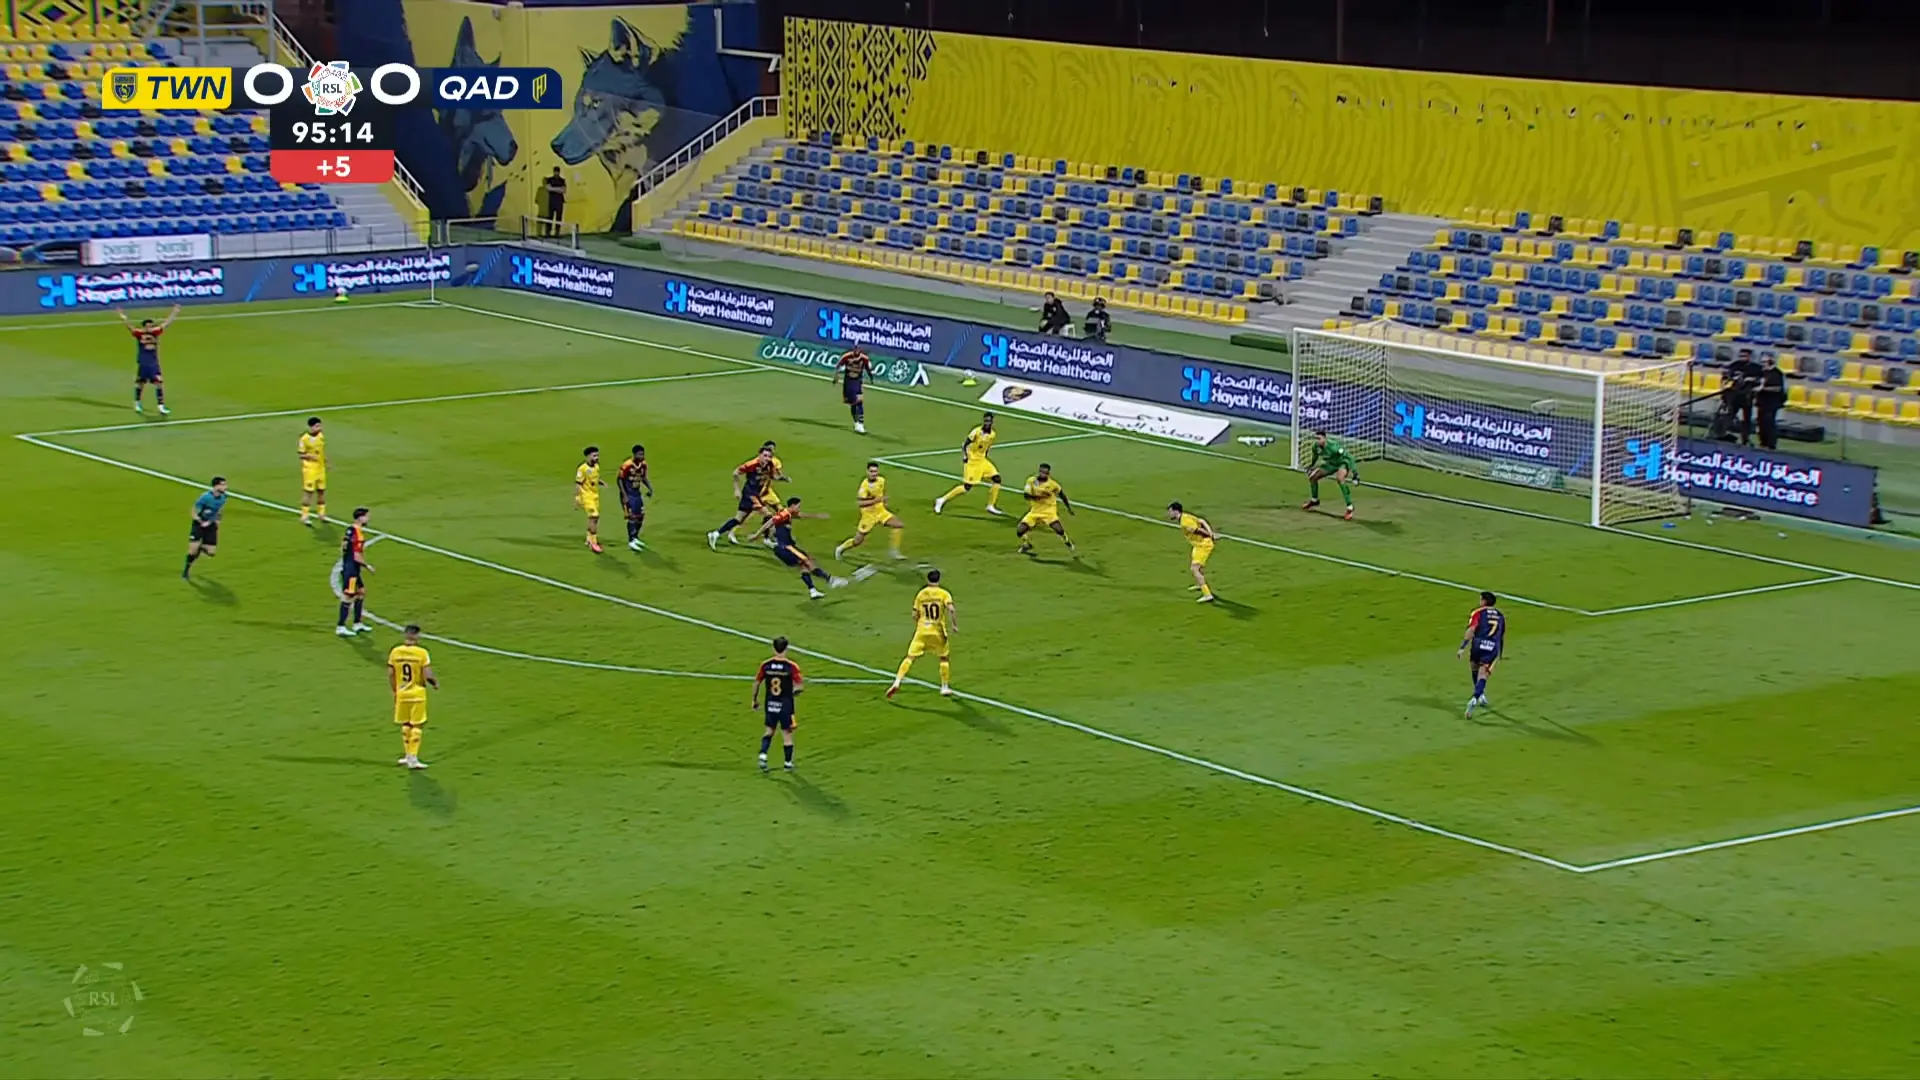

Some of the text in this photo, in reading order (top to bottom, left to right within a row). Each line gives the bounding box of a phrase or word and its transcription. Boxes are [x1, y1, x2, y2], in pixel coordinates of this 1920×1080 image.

[327, 270, 450, 288] Hayat Healthcare
[533, 273, 613, 297] Hayat Healthcare
[589, 268, 614, 283] الحياة
[76, 283, 223, 304] Hayat Healthcare
[687, 300, 773, 327] Hayat Healthcare
[747, 296, 775, 312] الحياة
[842, 327, 931, 353] Hayat Healthcare
[903, 323, 932, 338] الحياة
[762, 341, 814, 365] روشن
[1080, 350, 1114, 368] الحياة
[1008, 353, 1112, 383] Hayat Healthcare
[1212, 388, 1249, 409] Hayat
[1424, 425, 1550, 458] Hayat Healthcare
[1512, 423, 1552, 442] الحياة
[1771, 464, 1822, 486] الحياة
[1714, 473, 1819, 506] Healthcare
[922, 603, 940, 621] 10
[1487, 620, 1499, 637] 7
[402, 663, 412, 683] 9
[770, 677, 782, 696] 8
